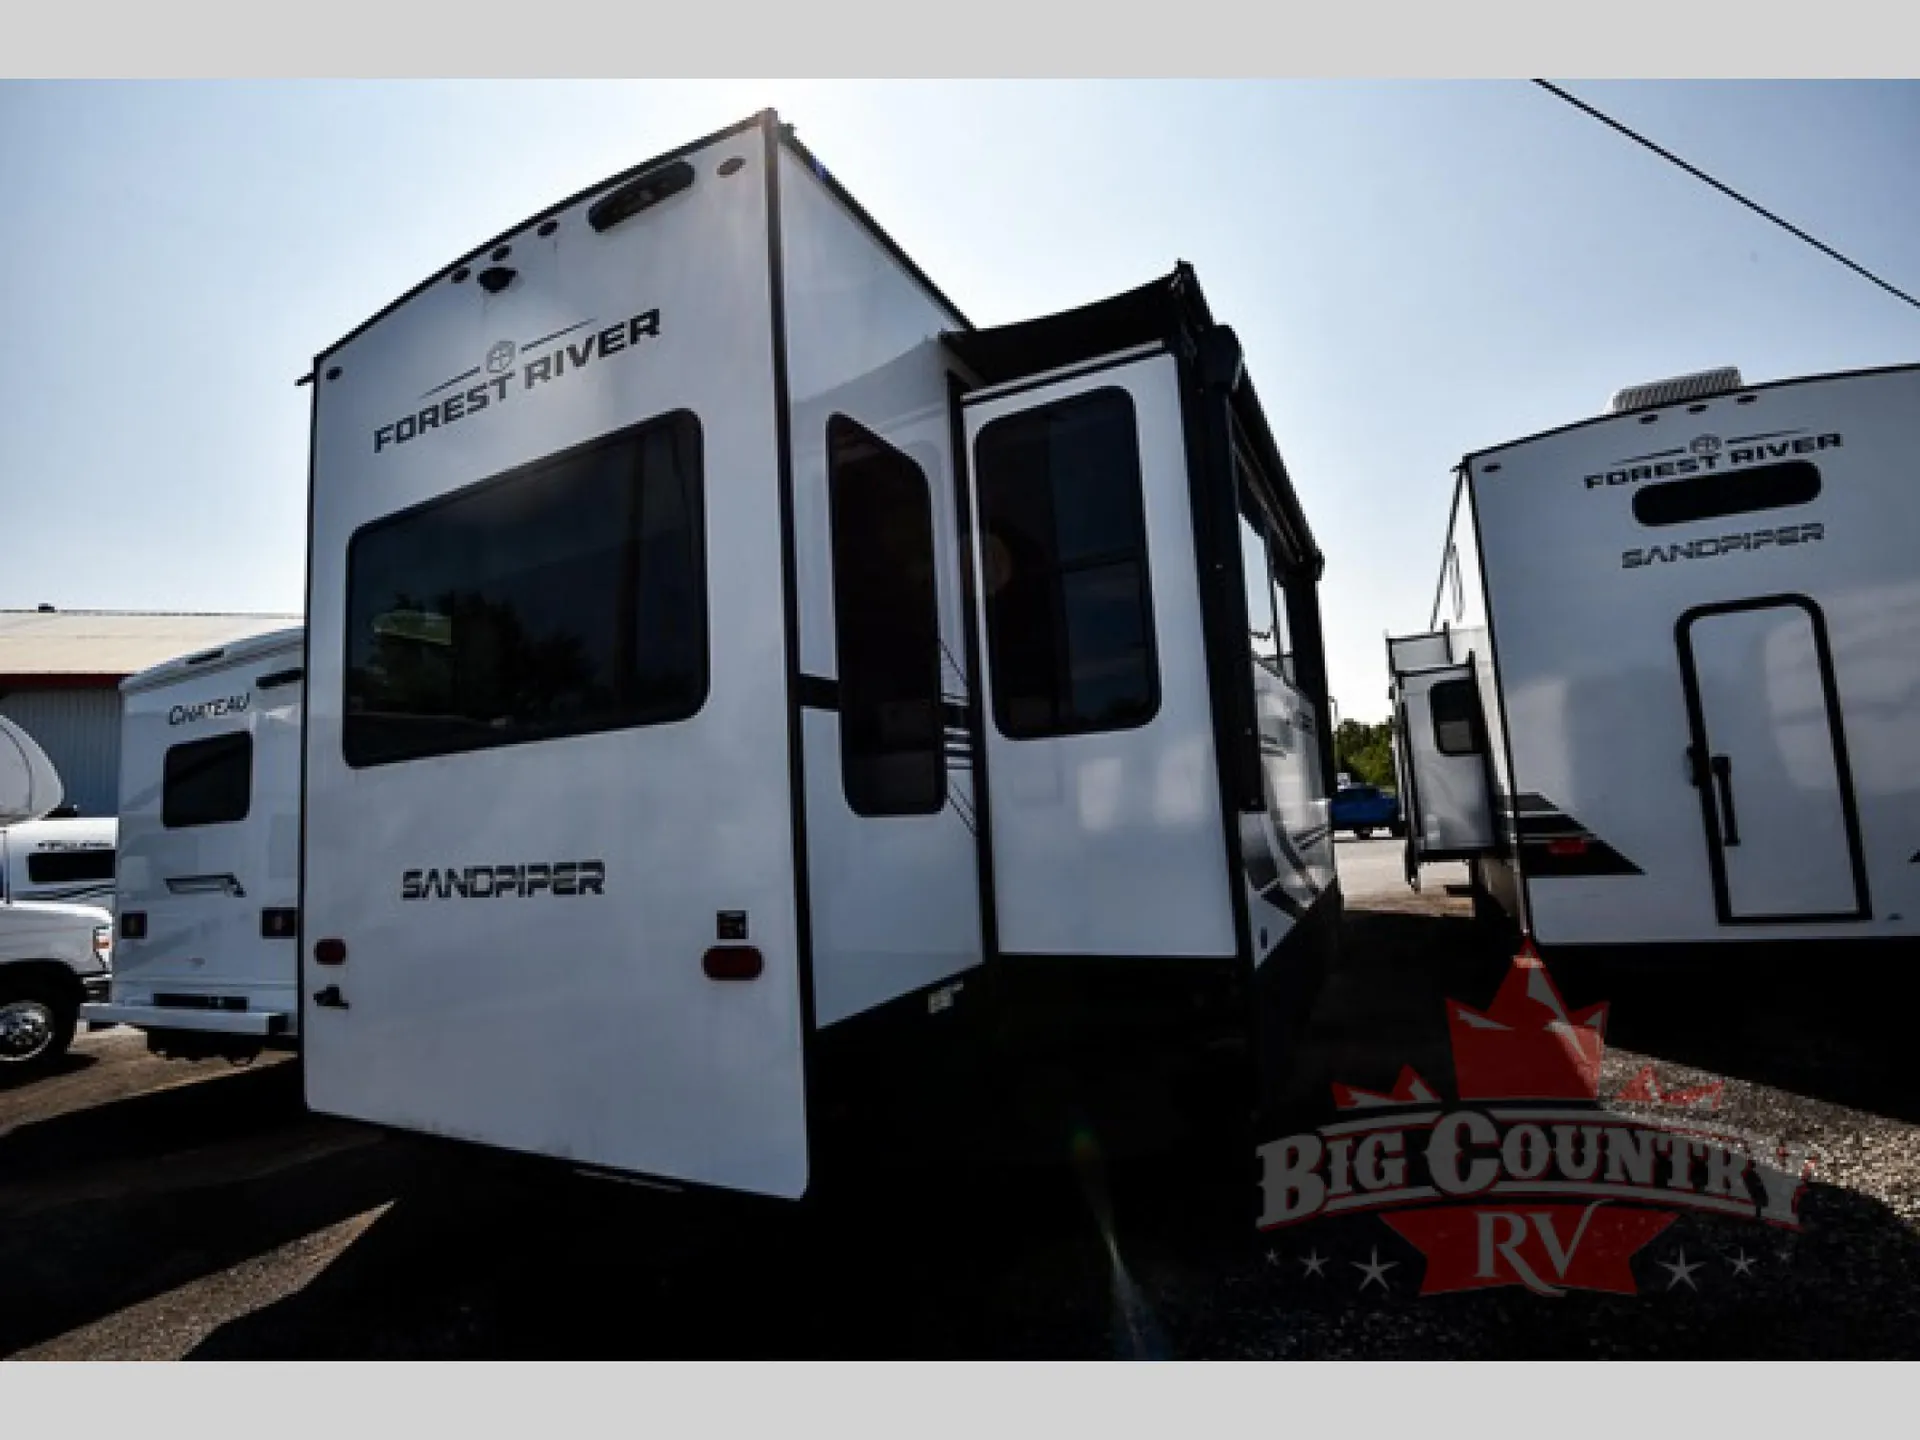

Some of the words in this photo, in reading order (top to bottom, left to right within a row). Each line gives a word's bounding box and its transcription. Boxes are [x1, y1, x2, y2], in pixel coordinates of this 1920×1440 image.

[374, 372, 516, 453] FOREST
[524, 308, 660, 389] RIVER
[1584, 452, 1721, 489] FOREST
[1731, 433, 1843, 465] RIVER
[1621, 523, 1825, 569] SANDPIPER
[402, 859, 606, 899] SANDPIPER
